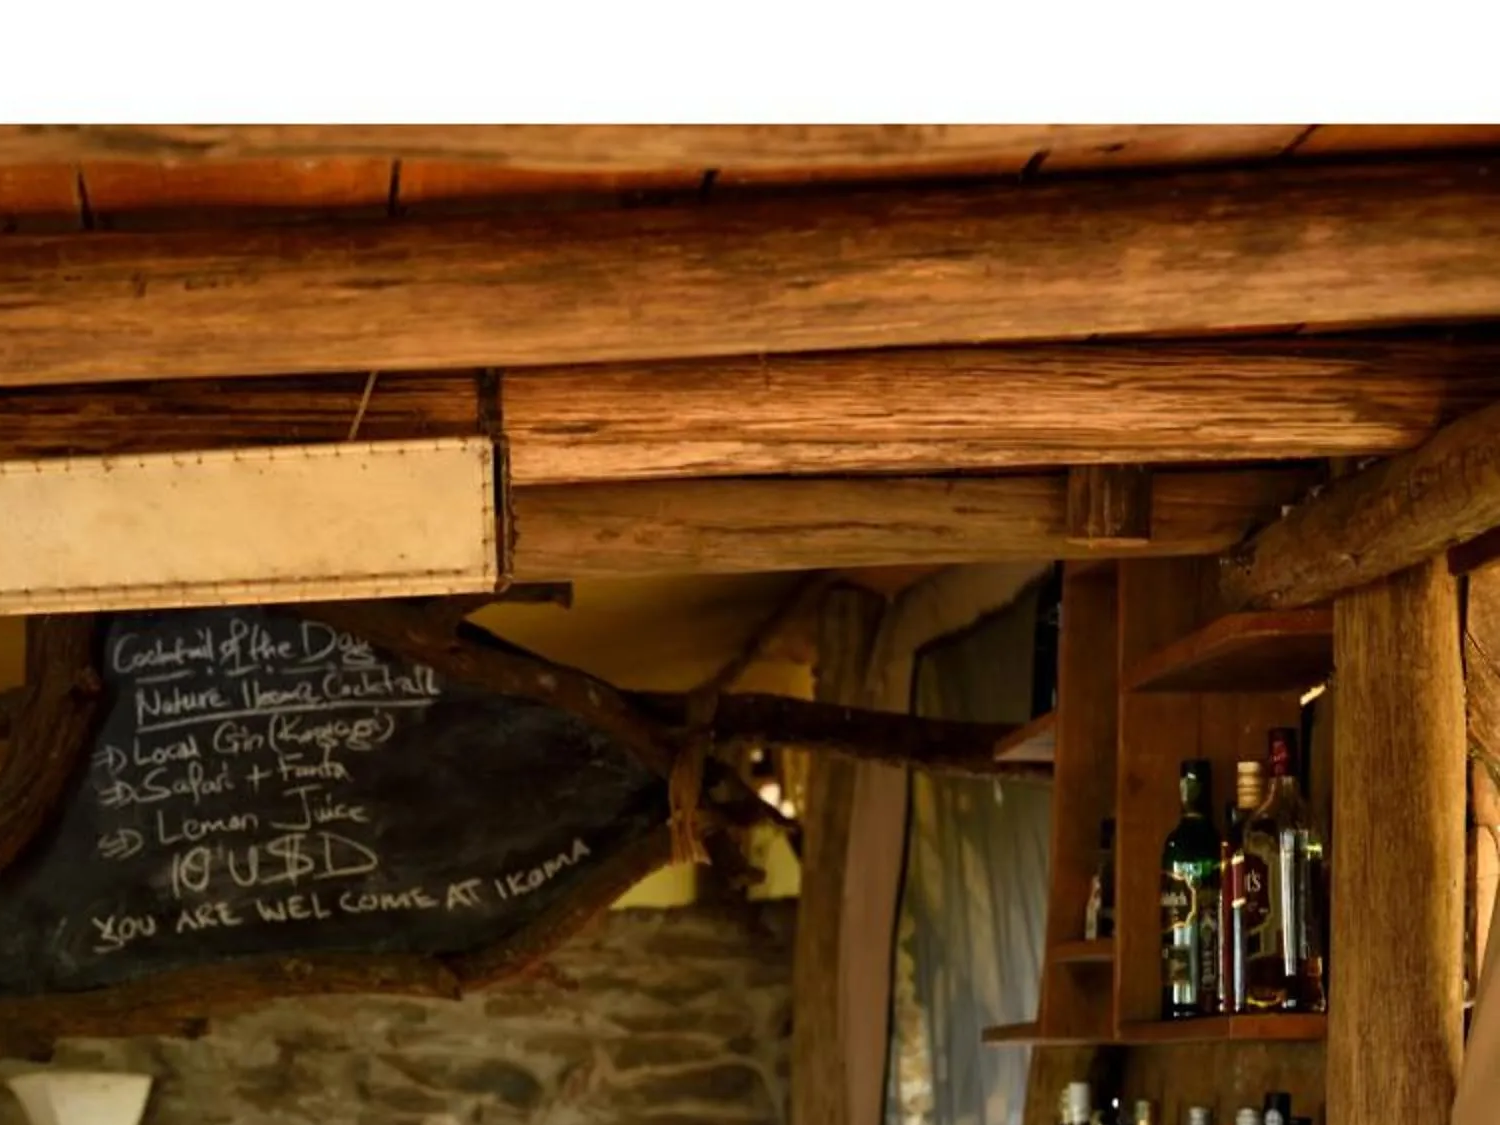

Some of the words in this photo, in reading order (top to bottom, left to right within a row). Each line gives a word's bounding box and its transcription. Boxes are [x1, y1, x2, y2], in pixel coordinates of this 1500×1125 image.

[113, 628, 214, 673] Cocktail
[221, 618, 249, 668] of
[251, 624, 292, 661] the
[299, 620, 377, 666] Day
[134, 734, 202, 766] Local
[213, 721, 264, 755] Gin
[156, 809, 259, 846] Lemon
[93, 915, 157, 953] YOU
[176, 902, 243, 934] ARE
[446, 877, 482, 911] AT
